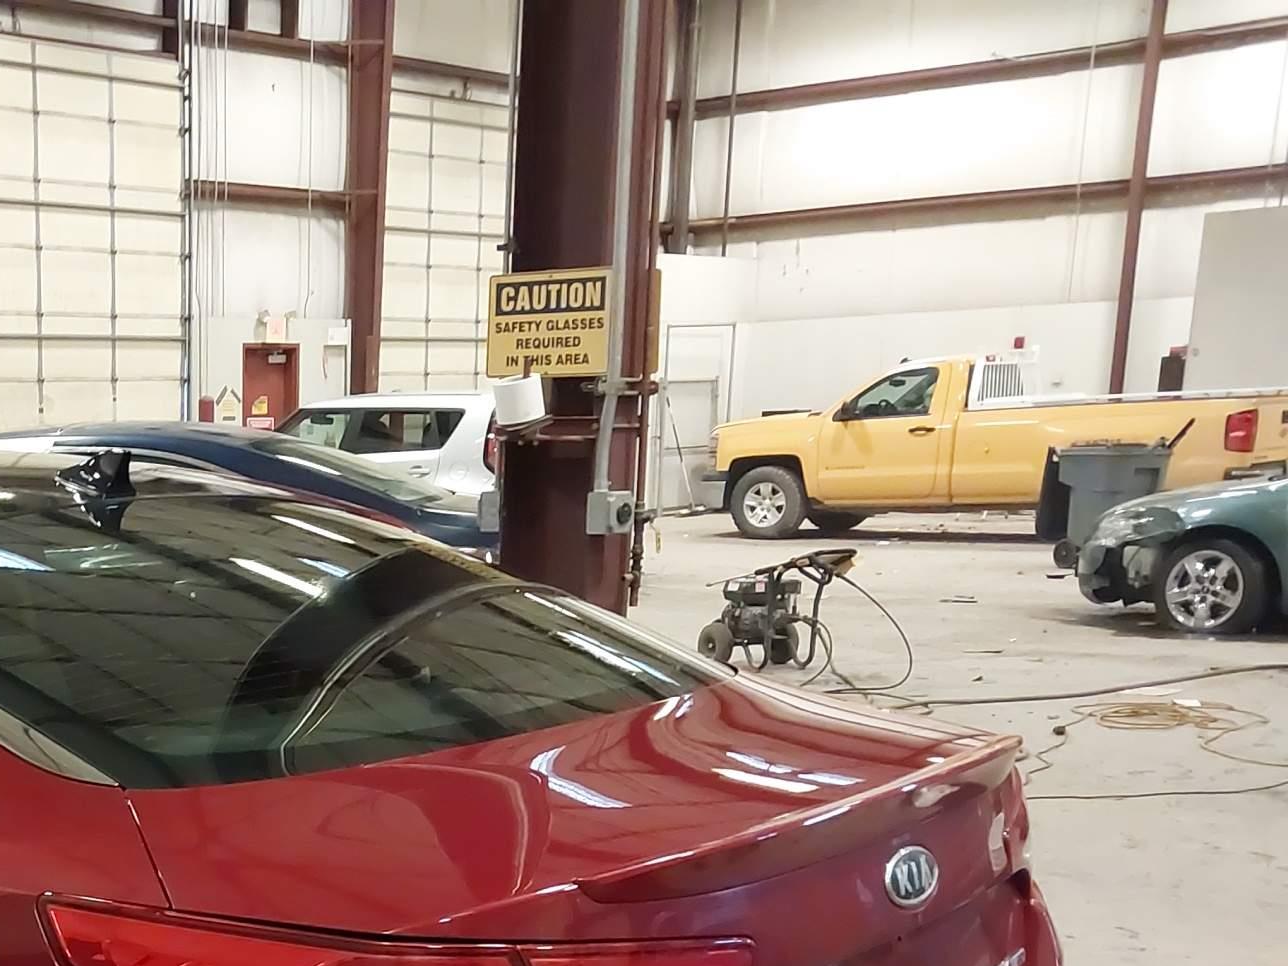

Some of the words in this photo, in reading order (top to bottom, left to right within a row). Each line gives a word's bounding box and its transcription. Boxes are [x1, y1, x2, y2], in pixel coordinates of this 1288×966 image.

[500, 281, 602, 312] CAUTION
[495, 319, 542, 334] SAFETY
[546, 316, 604, 331] GLASSES
[516, 335, 581, 350] REQUIRED
[506, 355, 519, 367] IN
[555, 352, 590, 365] AREA
